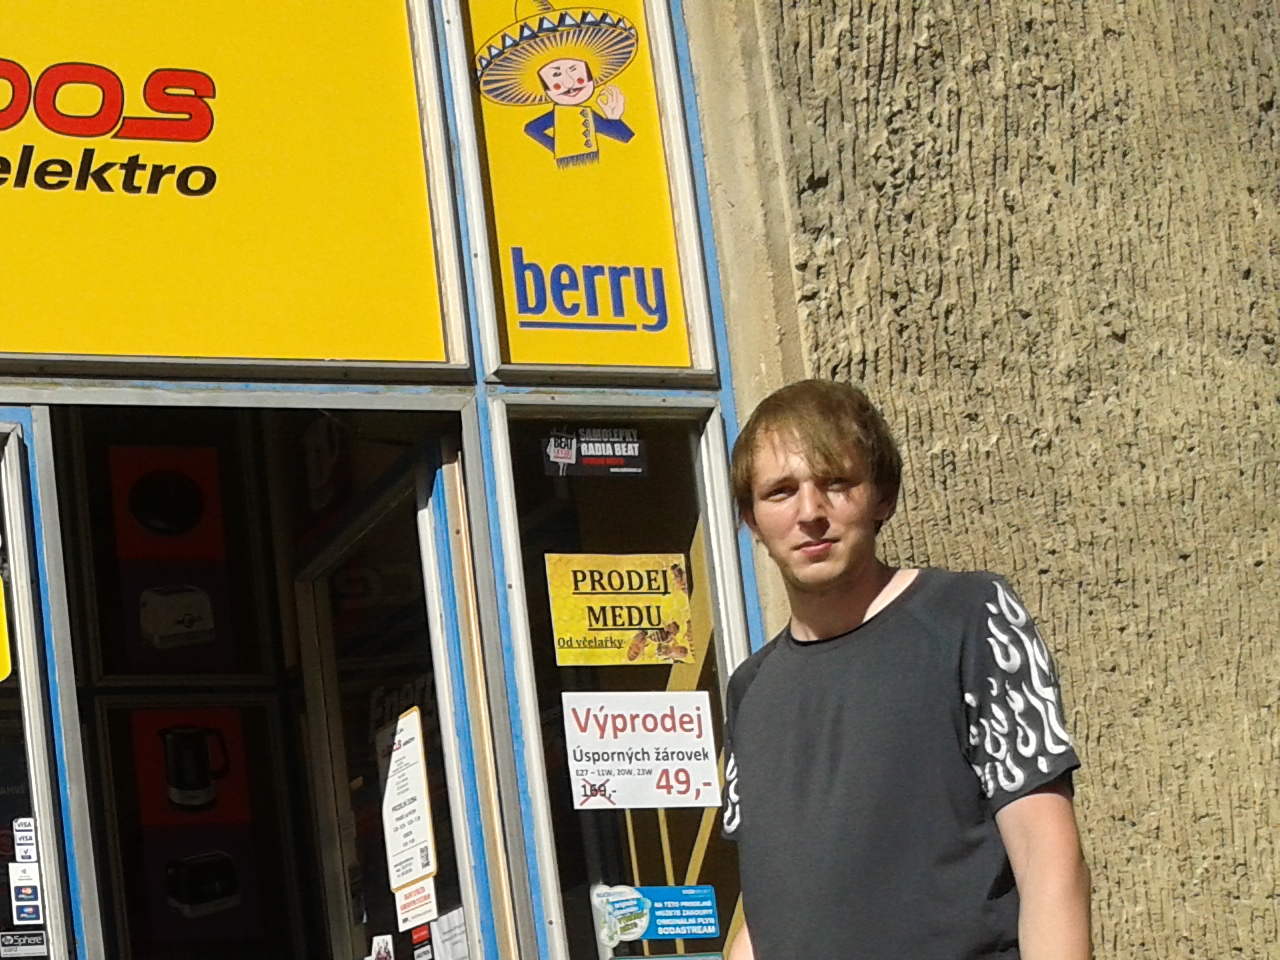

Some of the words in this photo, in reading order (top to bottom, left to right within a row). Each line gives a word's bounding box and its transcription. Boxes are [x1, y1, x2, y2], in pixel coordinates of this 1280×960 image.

[511, 246, 669, 332] berry
[580, 443, 613, 456] RADIA
[614, 443, 640, 456] BEAT
[572, 569, 670, 596] PRODEJ
[586, 605, 662, 627] MEDU
[557, 637, 573, 648] Od
[577, 637, 624, 650] včelařky
[571, 705, 704, 739] Výprodej
[573, 746, 650, 765] Úsporných
[654, 747, 709, 762] žárovek
[655, 767, 712, 801] 49,-
